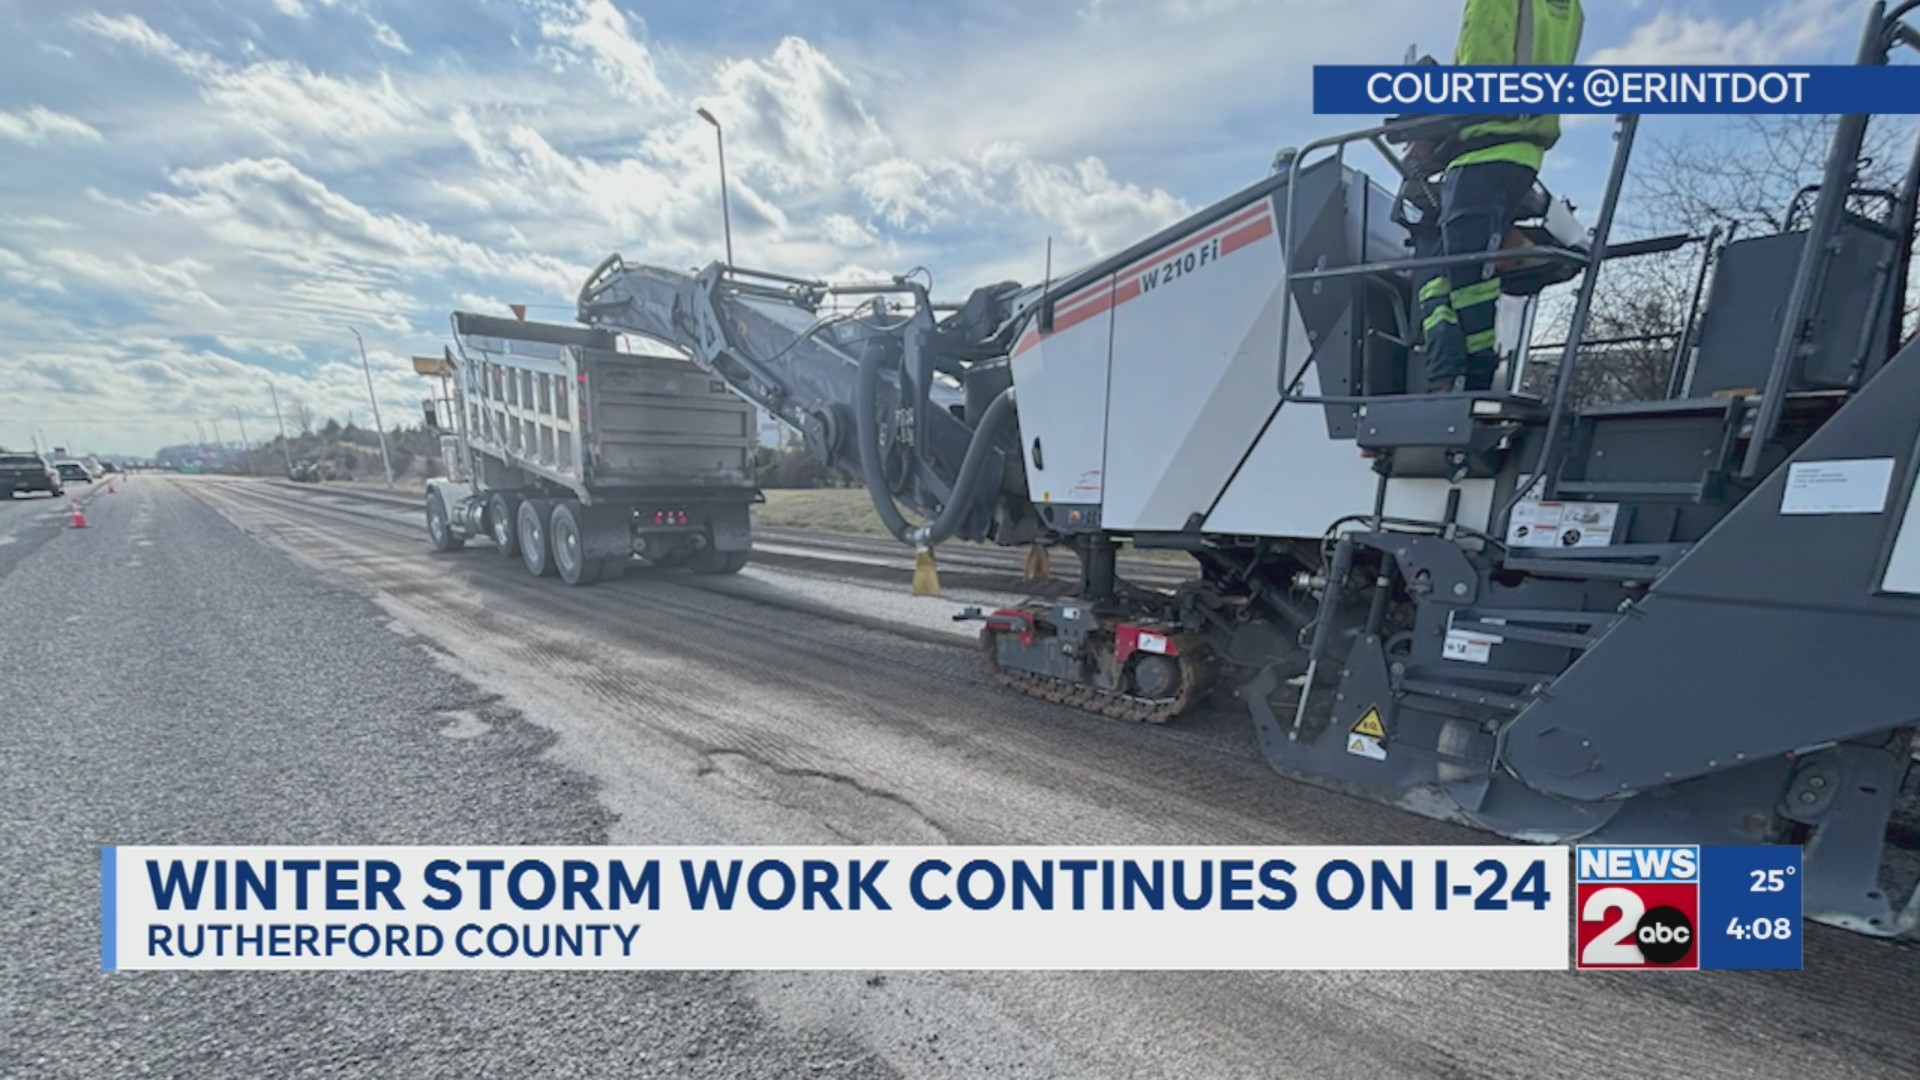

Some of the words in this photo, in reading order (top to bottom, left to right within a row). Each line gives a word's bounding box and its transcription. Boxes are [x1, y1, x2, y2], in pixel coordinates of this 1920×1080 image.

[1142, 268, 1159, 293] W
[1162, 251, 1196, 285] 210
[1200, 238, 1218, 268] Fi
